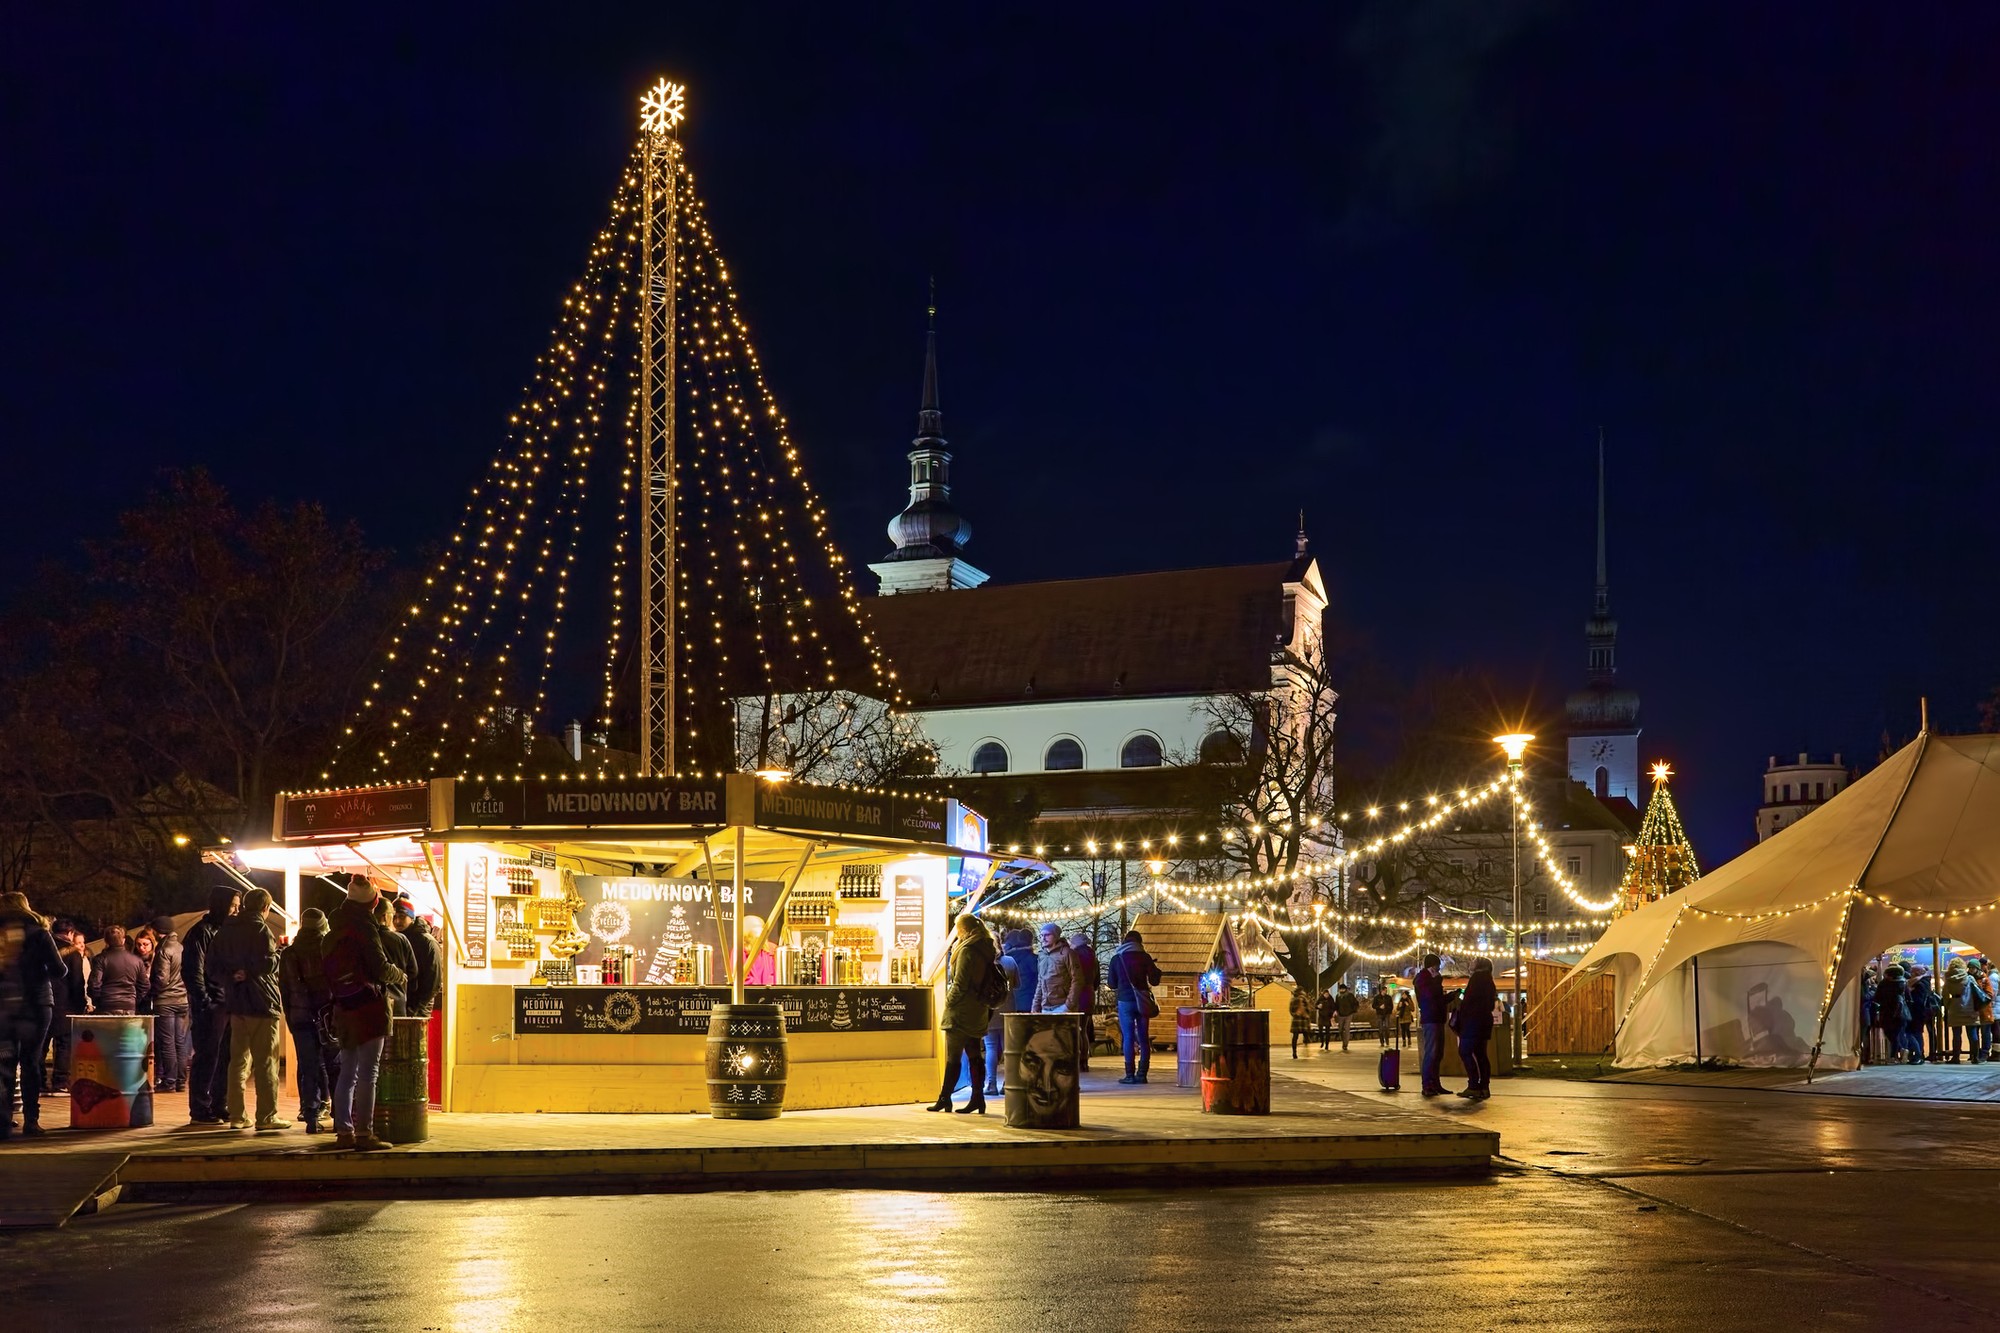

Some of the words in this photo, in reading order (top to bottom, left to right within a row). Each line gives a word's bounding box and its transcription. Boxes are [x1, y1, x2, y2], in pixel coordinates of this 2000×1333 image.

[547, 787, 673, 813] MEDOVINOVÝ
[679, 791, 717, 812] BAR
[761, 793, 851, 821] MEDOVINOVÝ
[856, 804, 881, 825] BAR
[522, 999, 564, 1010] MEDOVINA
[678, 1000, 720, 1010] MEDOVIN
